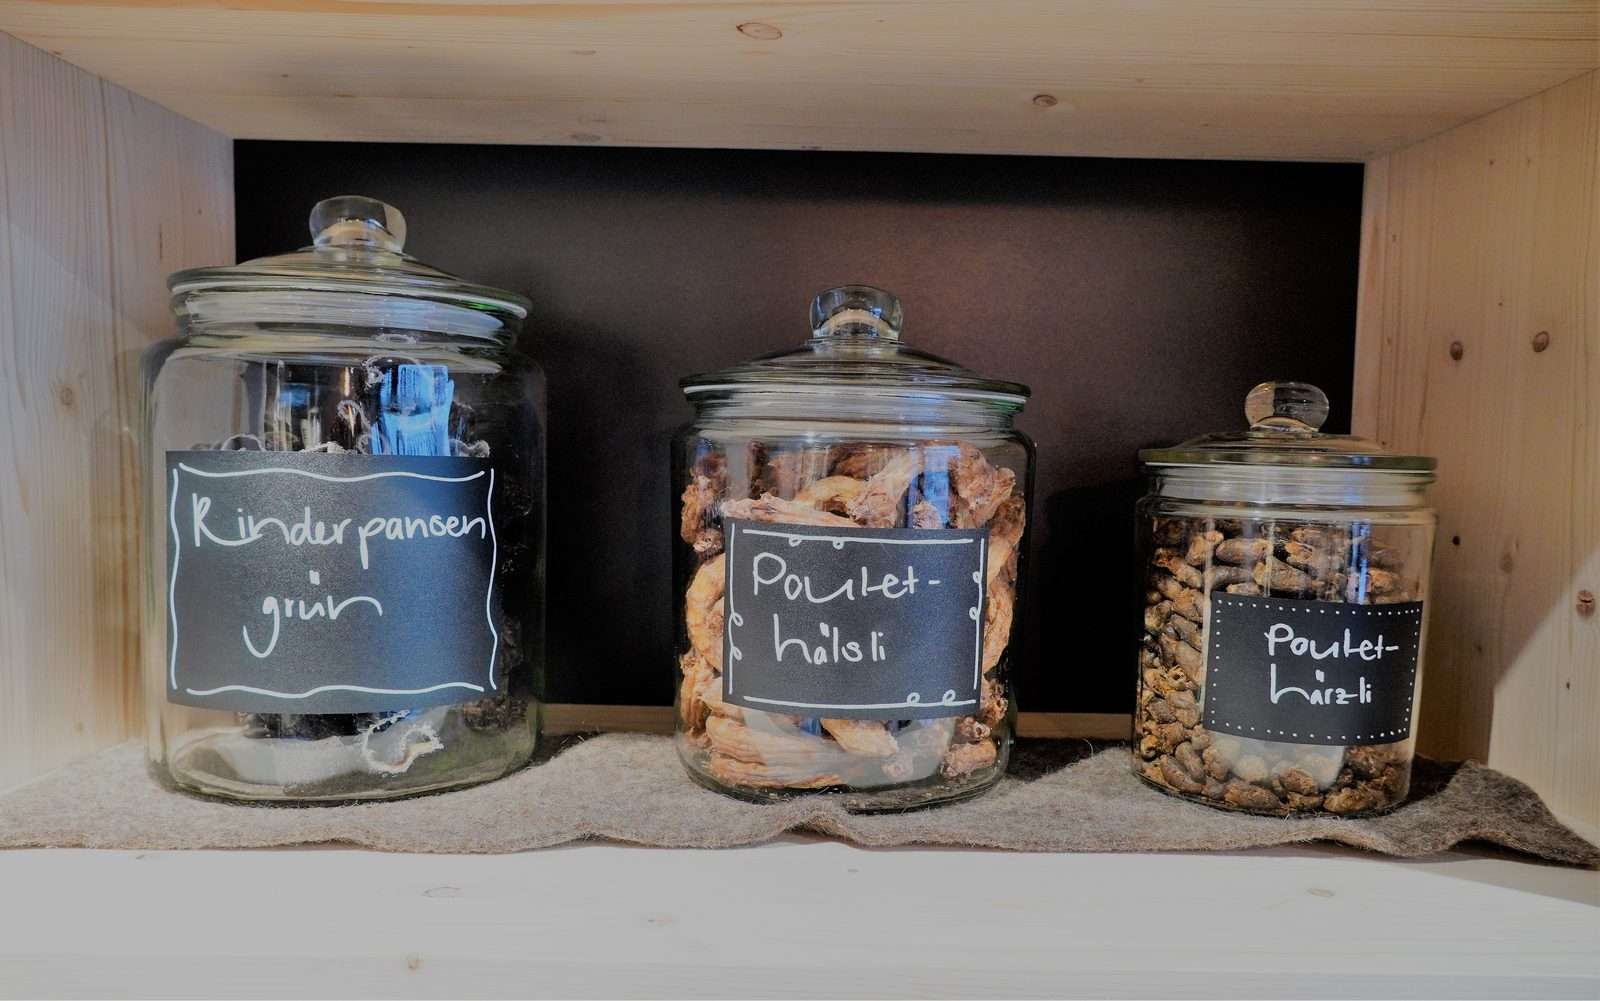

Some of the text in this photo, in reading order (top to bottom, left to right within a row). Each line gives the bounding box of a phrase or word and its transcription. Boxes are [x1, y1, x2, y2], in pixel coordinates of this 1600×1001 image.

[752, 551, 941, 604] Poulet-
[242, 570, 383, 658] grün
[773, 613, 886, 665] hälsli
[1264, 623, 1399, 661] Poulet-
